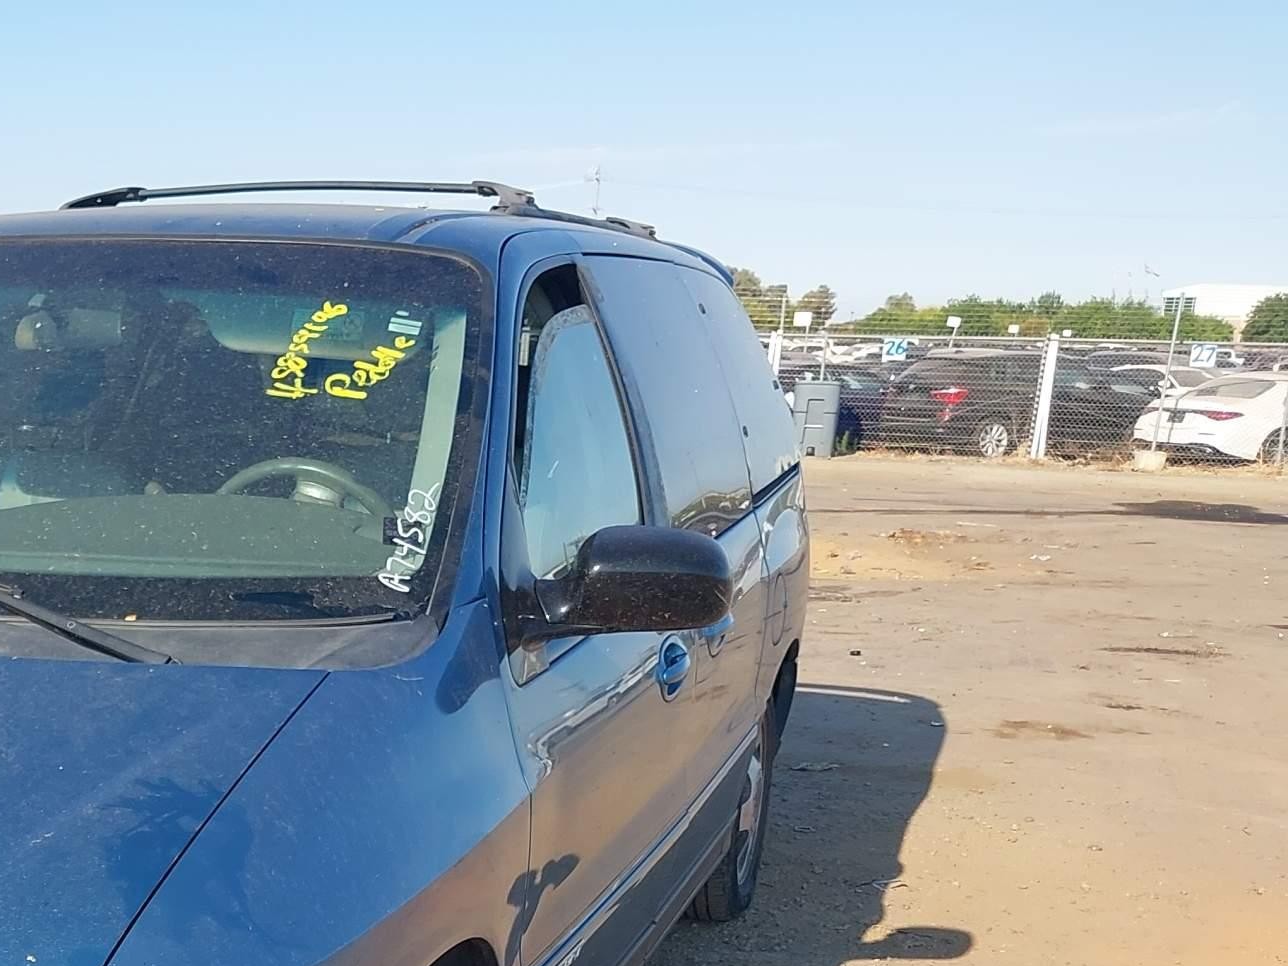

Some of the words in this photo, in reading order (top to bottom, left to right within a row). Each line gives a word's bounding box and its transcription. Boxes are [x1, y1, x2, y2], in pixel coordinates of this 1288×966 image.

[886, 339, 908, 356] 26
[1191, 344, 1216, 363] 27
[378, 481, 440, 593] A74582
